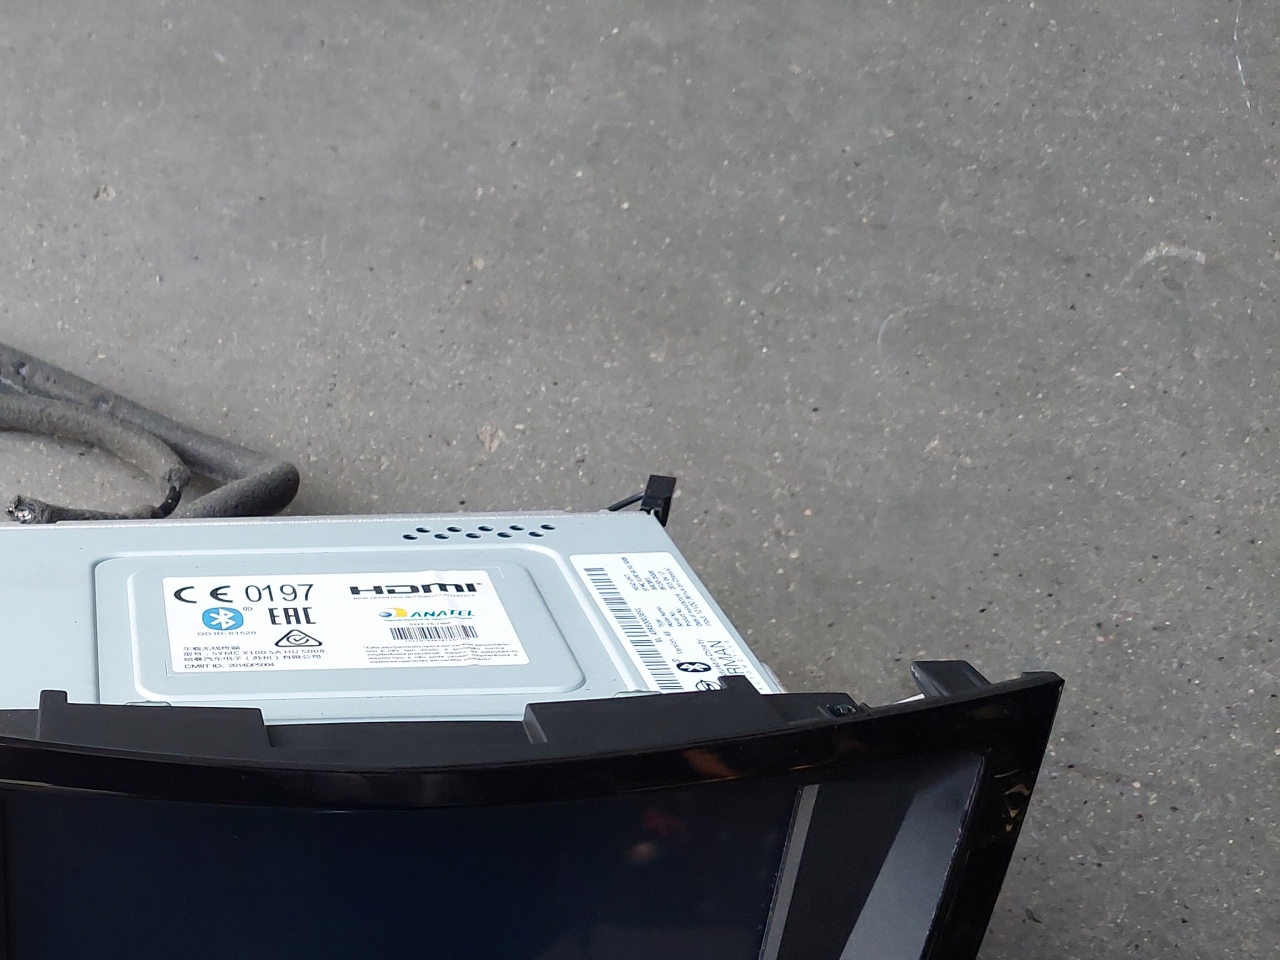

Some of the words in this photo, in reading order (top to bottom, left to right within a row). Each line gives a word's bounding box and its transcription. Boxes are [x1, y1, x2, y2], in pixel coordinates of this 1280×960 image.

[245, 583, 314, 603] 0197
[350, 582, 477, 595] HDMI
[268, 607, 317, 626] EAC
[411, 609, 475, 618] ANATEL
[704, 639, 746, 674] RMAN
